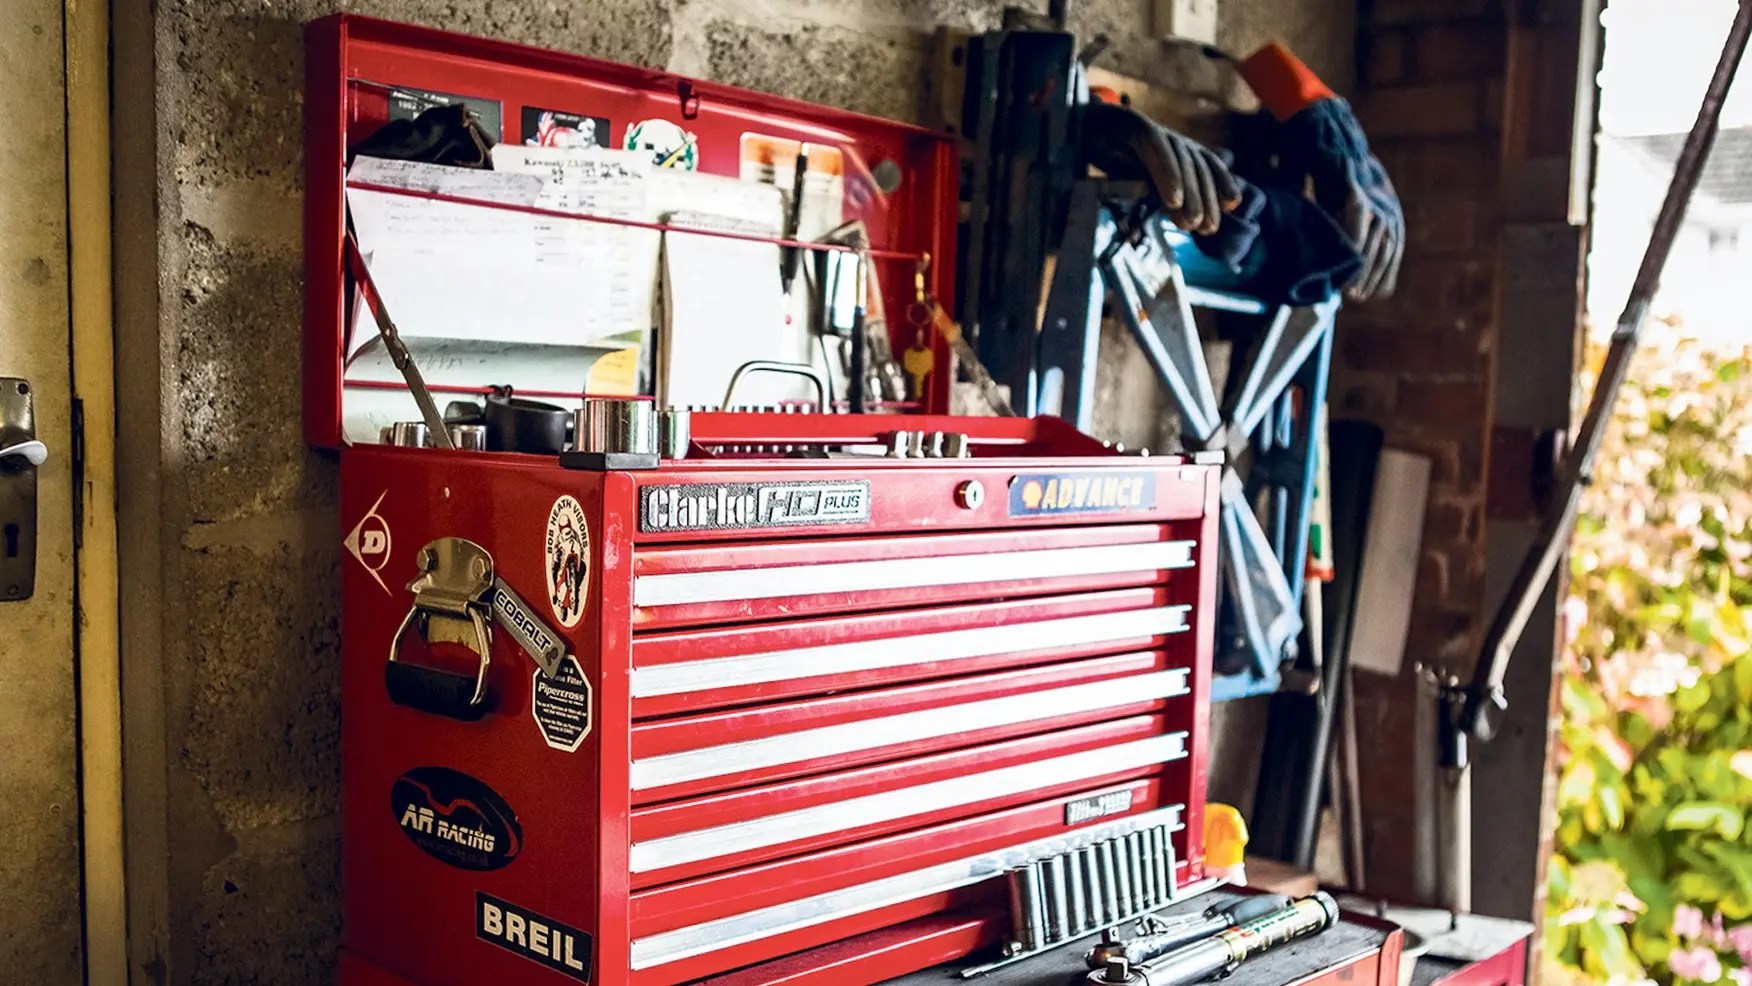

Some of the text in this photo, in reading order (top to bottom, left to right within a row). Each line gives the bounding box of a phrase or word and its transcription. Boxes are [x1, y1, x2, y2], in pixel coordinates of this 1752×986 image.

[648, 487, 757, 528] Clarke
[823, 495, 860, 509] PLUS
[1041, 476, 1145, 509] ADVANCE
[361, 530, 386, 554] D
[547, 499, 588, 555] BOB HEATH VISORS
[494, 588, 553, 652] COBALT
[537, 681, 585, 702] Pipercross
[400, 803, 495, 853] AR RACING
[483, 902, 583, 971] BREIL
